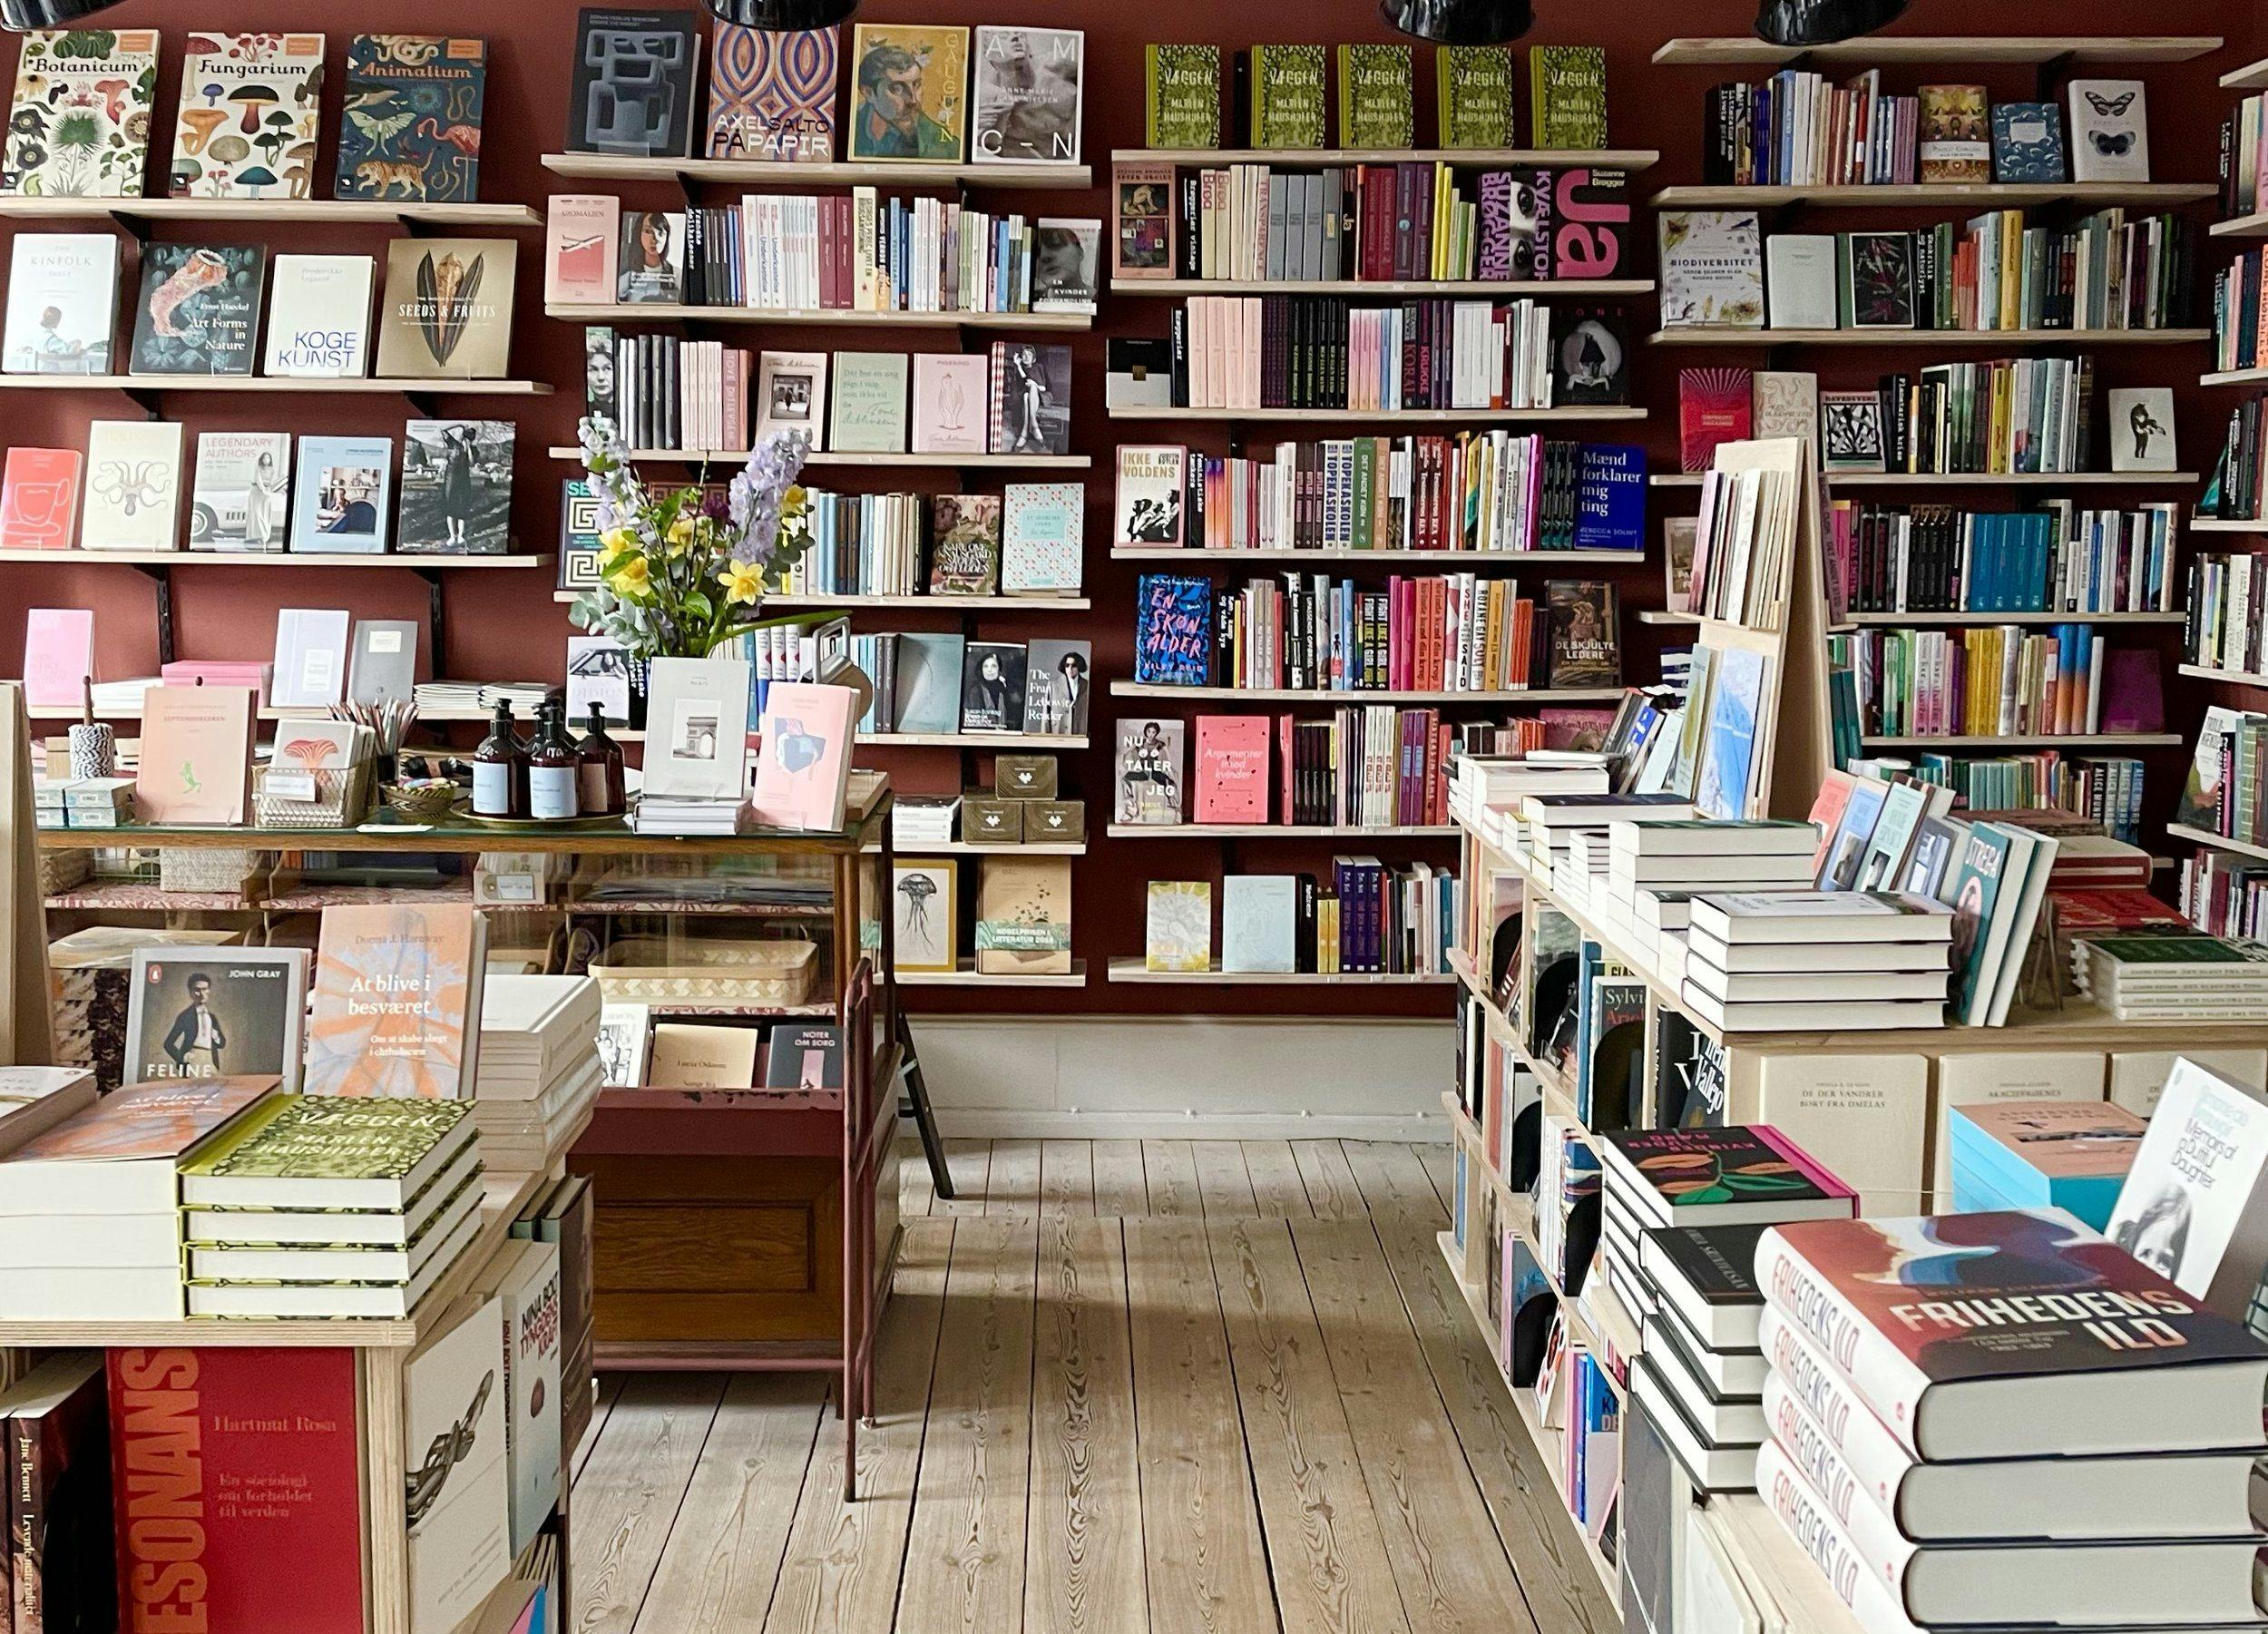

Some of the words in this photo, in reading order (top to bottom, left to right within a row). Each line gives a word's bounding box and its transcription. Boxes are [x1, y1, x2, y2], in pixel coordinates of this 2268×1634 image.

[34, 59, 138, 73] Botanicum
[199, 59, 307, 79] Fungarium
[359, 62, 473, 78] Animalium
[1165, 69, 1213, 85] VÆGGEN
[1270, 71, 1317, 85] VÆGGEN
[1358, 71, 1406, 85] VÆGGEN
[1457, 72, 1505, 86] VÆGGEN
[1550, 72, 1598, 87] VÆGGEN
[717, 114, 767, 130] AXEL
[768, 116, 830, 134] SALTO
[713, 128, 747, 152] PÅ
[746, 134, 828, 157] PAPIR
[1479, 171, 1497, 281] BRØGGER
[1496, 171, 1511, 281] SUZANNE
[1533, 171, 1551, 281] KVÆLSTOF
[31, 257, 92, 266] KINFOLK
[759, 236, 768, 294] Underkastelse
[771, 237, 780, 294] Underkastelse
[1670, 259, 1754, 267] BIODIVERSITET
[205, 339, 245, 351] Nature
[295, 331, 357, 350] KOGE
[279, 350, 355, 368] KUNST
[1420, 345, 1432, 395] KRUKKE
[205, 449, 258, 458] AUTHORS
[1123, 453, 1150, 465] IKKE
[1583, 452, 1627, 466] Mænd
[1123, 466, 1176, 478] VOLDENS
[1582, 466, 1642, 484] forklarer
[1325, 455, 1338, 541] TOPEKASKOLEN
[1339, 455, 1353, 541] TOPEKASKOLEN
[1582, 484, 1608, 500] mig
[1581, 500, 1608, 516] ting
[1151, 588, 1177, 610] EN
[1479, 590, 1488, 623] ROXANE
[1364, 598, 1374, 621] FIGHT
[1378, 598, 1387, 621] FIGHT
[1151, 609, 1200, 635] SKØN
[1147, 634, 1201, 659] ALDER
[1556, 641, 1569, 651] DE
[1571, 641, 1615, 651] SKJULTE
[1566, 650, 1605, 660] LEDERE
[1461, 643, 1469, 688] SAID
[1030, 669, 1051, 680] The
[1029, 682, 1052, 695] Fran
[1027, 709, 1063, 722] Reader
[1123, 736, 1144, 747] NU
[1204, 749, 1264, 759] Argumenter
[1125, 760, 1171, 771] TALER
[1215, 769, 1251, 779] kvinder
[2093, 768, 2104, 792] ALICE
[1146, 785, 1176, 796] JEG
[228, 970, 254, 979] JOHN
[257, 970, 281, 979] GRAY
[349, 976, 373, 993] At
[375, 975, 420, 993] blive
[423, 975, 432, 992] i
[347, 999, 432, 1017] besværet
[1605, 988, 1644, 1012] Sylvi
[370, 1035, 386, 1044] Om
[812, 1039, 836, 1047] SORG
[146, 1063, 213, 1078] FELINE
[1802, 1090, 1813, 1098] DE
[1815, 1090, 1836, 1098] DER
[1839, 1090, 1884, 1099] VANDRER
[1847, 1100, 1886, 1108] OMELAS
[299, 1112, 447, 1127] VÆGGEN
[256, 1144, 402, 1158] HAUSHOFER
[1772, 1253, 1838, 1351] FRIHEDENS
[1833, 1318, 1861, 1374] ILD
[1888, 1290, 2195, 1332] FRIHEDENS
[2082, 1317, 2189, 1351] ILD
[1774, 1324, 1831, 1424] FRIHEDENS
[1826, 1394, 1850, 1450] ILD
[214, 1416, 288, 1432] Hartmut
[296, 1417, 337, 1432] Rosa
[1777, 1394, 1835, 1500] FRIHEDENS
[1831, 1465, 1855, 1531] ILD
[1773, 1470, 1837, 1580] FRIHEDENS
[1832, 1548, 1859, 1609] ILD
